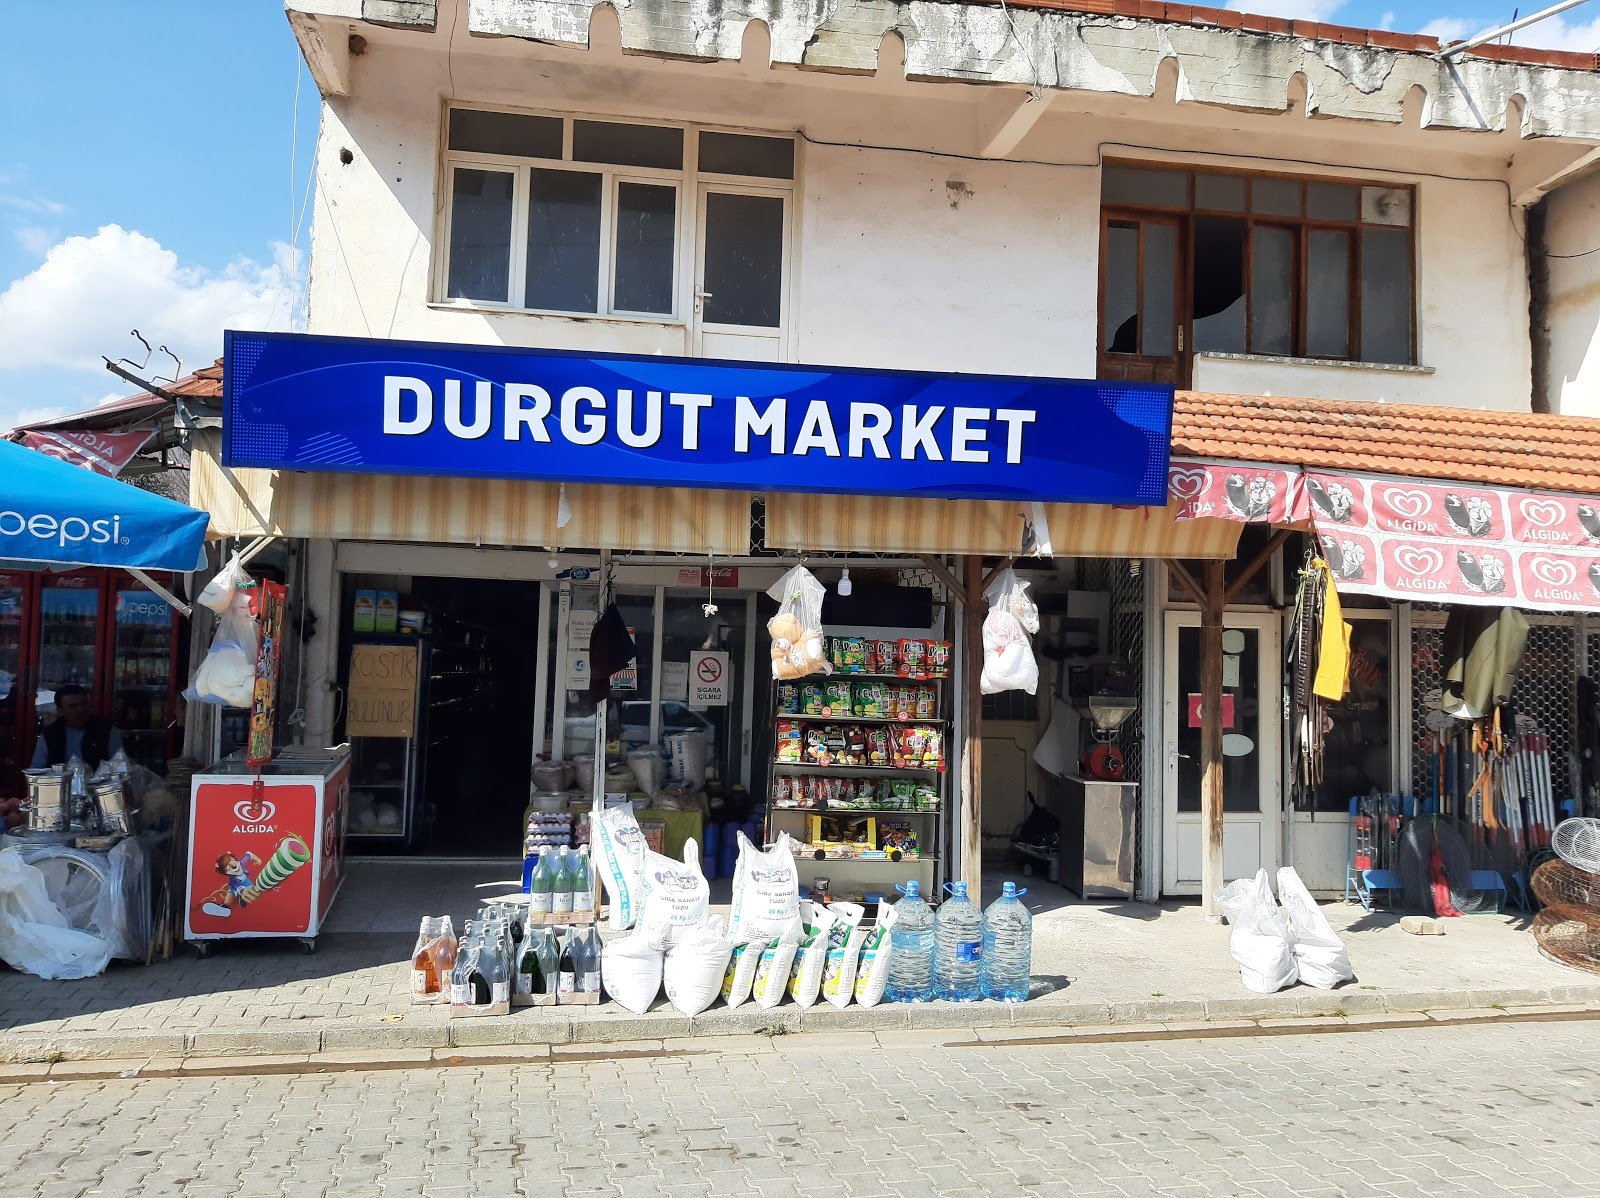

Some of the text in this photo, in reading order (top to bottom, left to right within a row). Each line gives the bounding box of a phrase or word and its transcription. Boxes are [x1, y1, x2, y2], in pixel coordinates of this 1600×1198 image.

[383, 375, 1037, 464] DURGUT MARKET
[128, 602, 168, 618] pepsi
[697, 685, 722, 693] SİGARA
